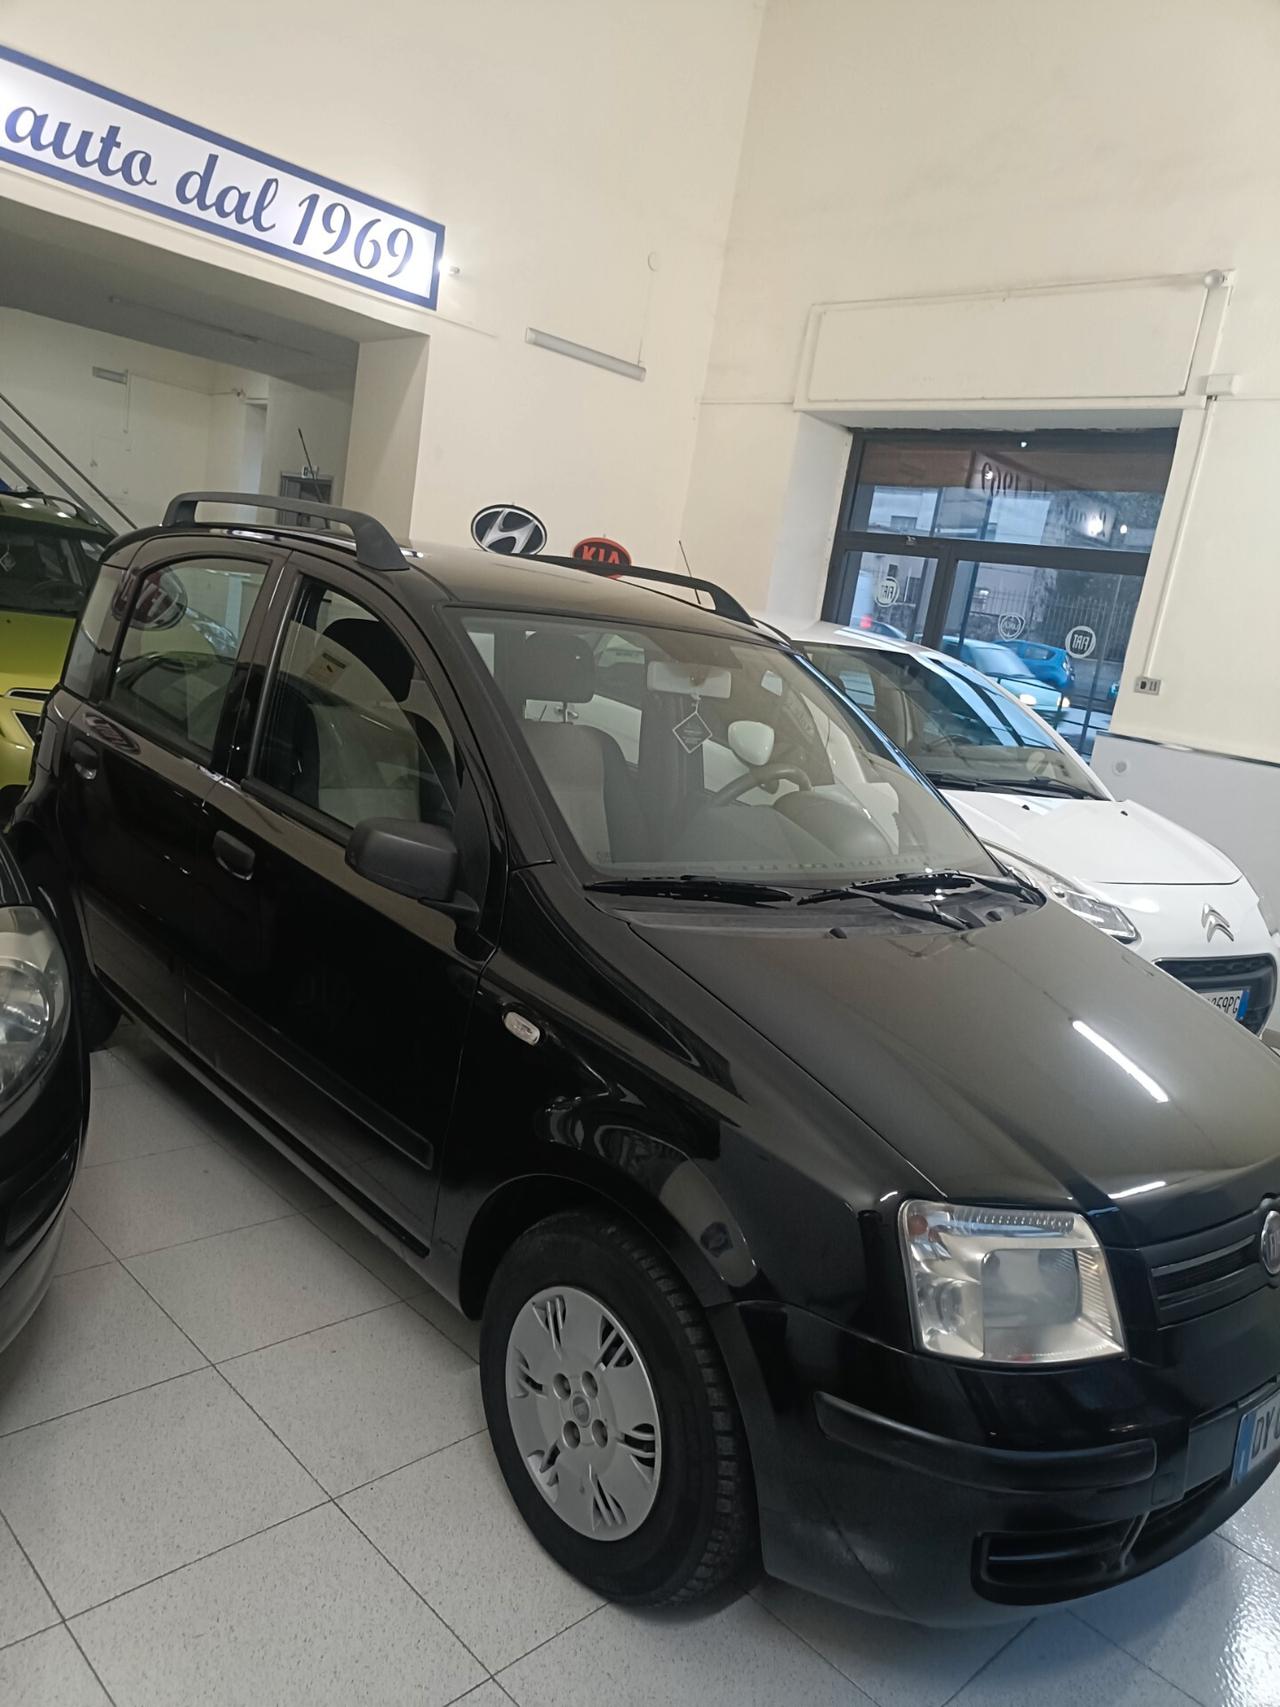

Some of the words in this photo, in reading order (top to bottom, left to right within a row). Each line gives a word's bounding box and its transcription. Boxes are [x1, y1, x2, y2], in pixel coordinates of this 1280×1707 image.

[4, 105, 158, 187] auto
[174, 152, 280, 233] dal
[292, 192, 415, 279] 1969
[582, 544, 620, 565] KIA
